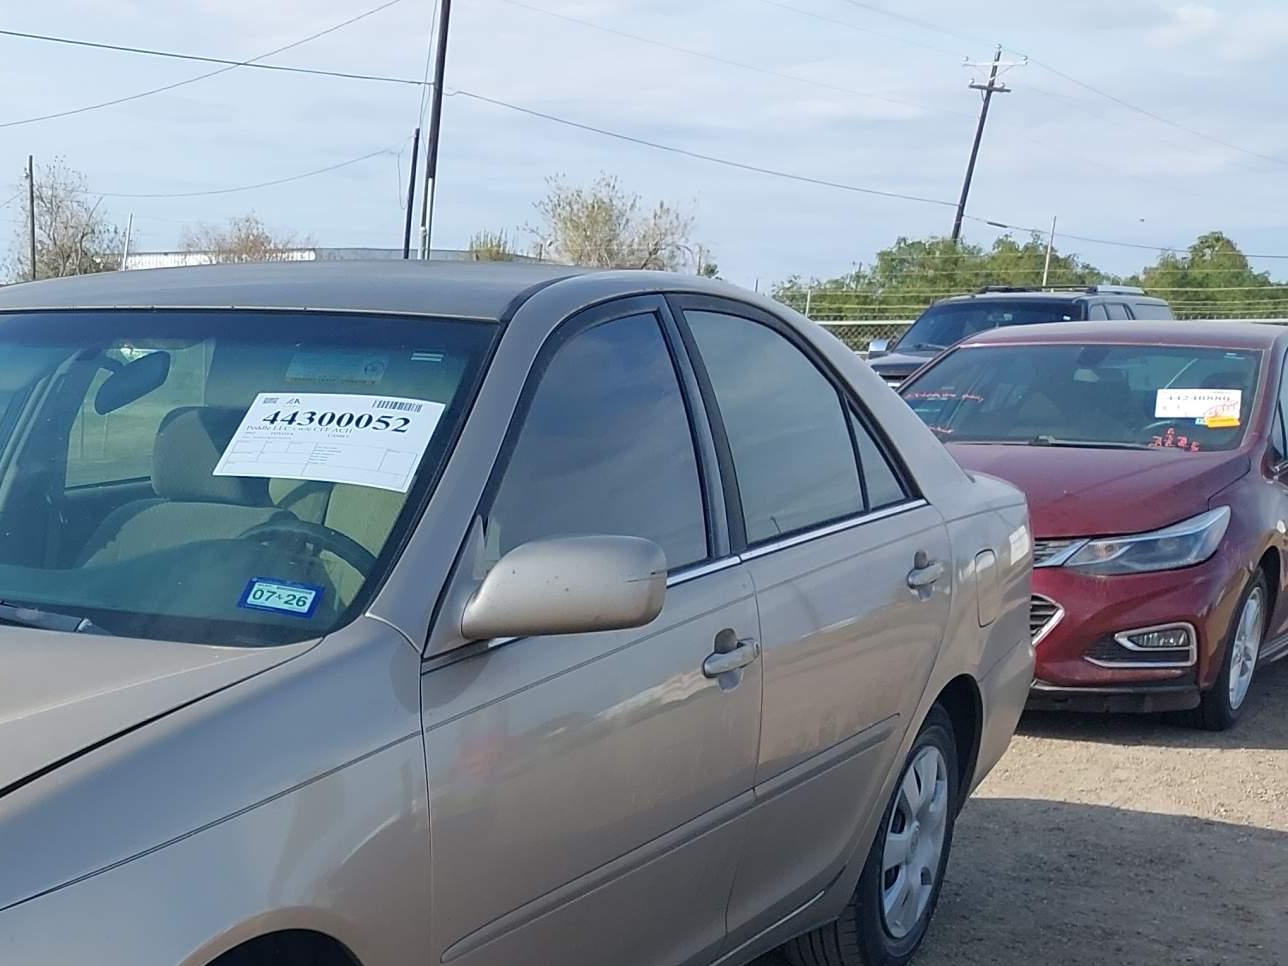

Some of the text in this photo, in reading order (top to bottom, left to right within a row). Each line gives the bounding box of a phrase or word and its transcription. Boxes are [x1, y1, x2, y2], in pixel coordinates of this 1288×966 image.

[262, 410, 411, 434] 44300052
[252, 589, 309, 607] 07 26
